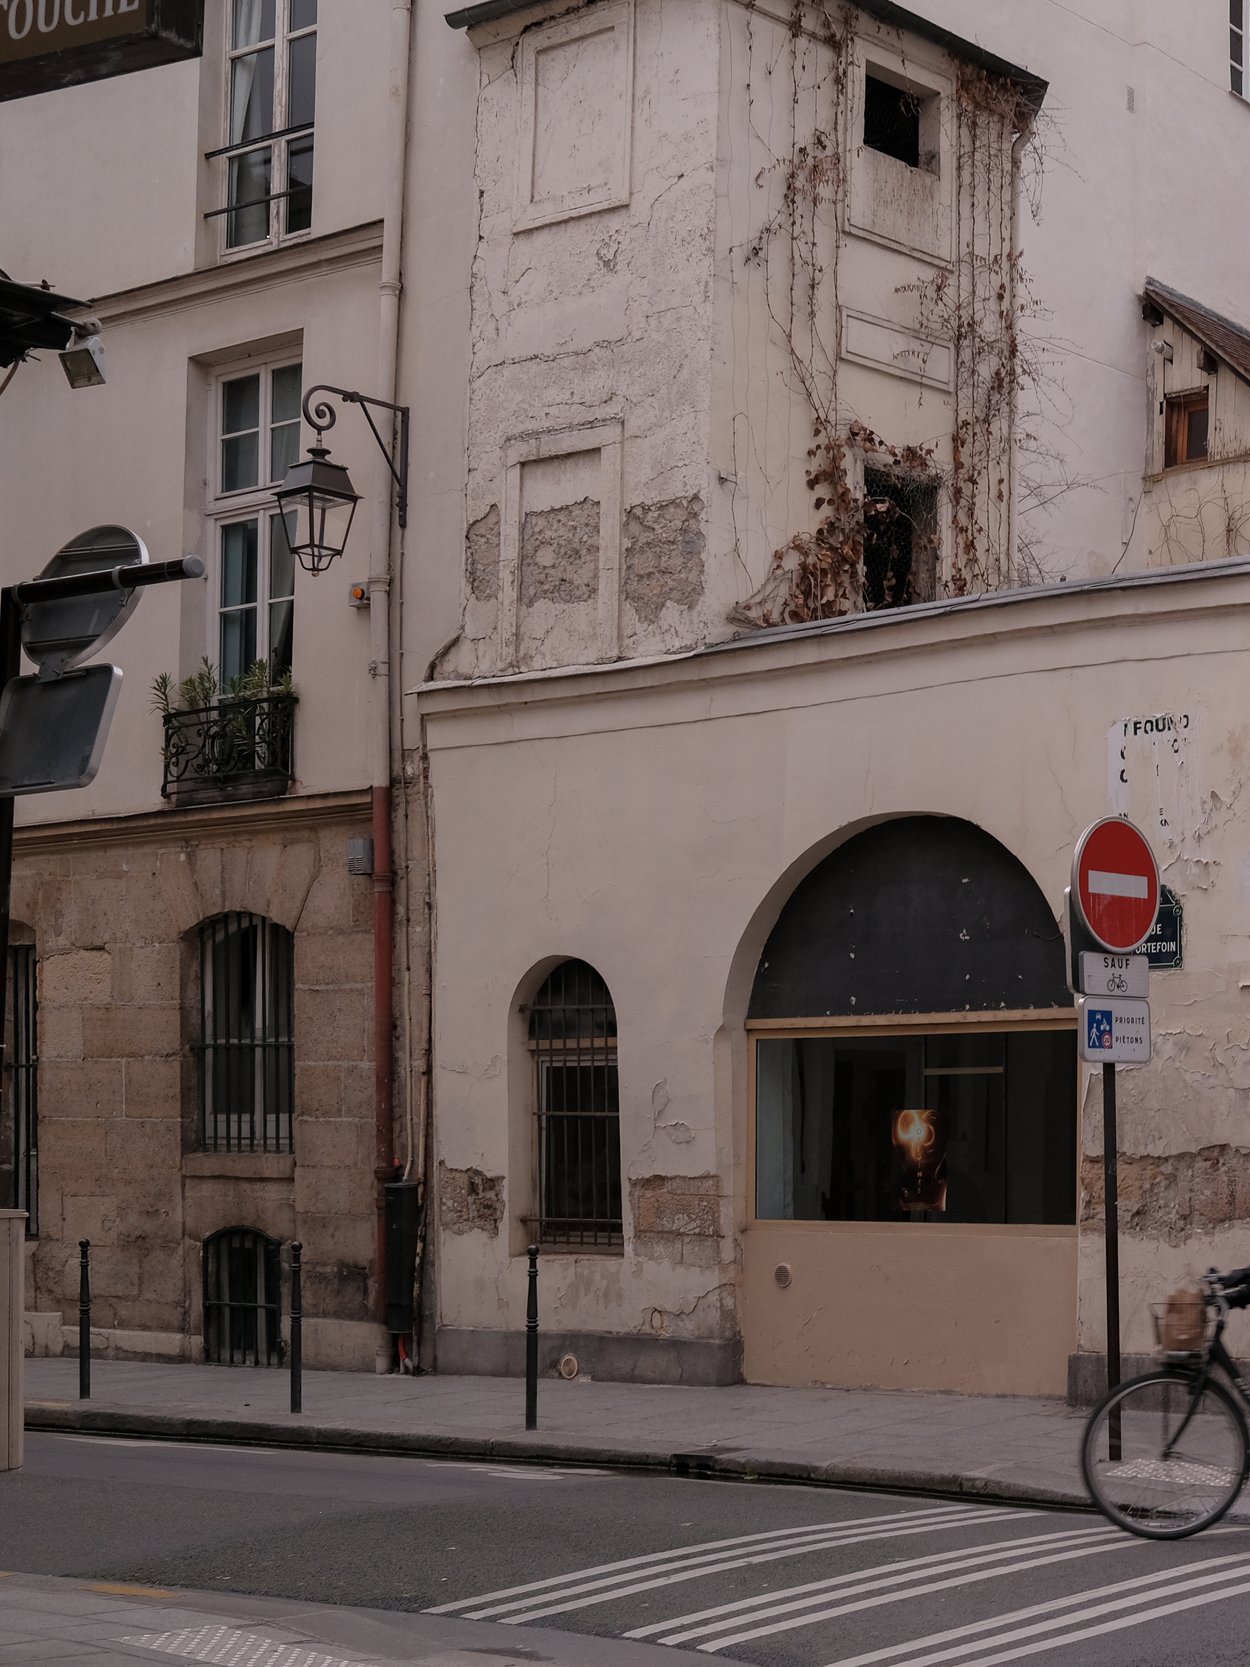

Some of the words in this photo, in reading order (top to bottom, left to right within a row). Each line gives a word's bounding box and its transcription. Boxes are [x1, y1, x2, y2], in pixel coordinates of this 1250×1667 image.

[1150, 923, 1163, 935] UE
[1135, 941, 1176, 954] ORTEFOIN
[1103, 956, 1131, 970] SAUF
[1114, 1016, 1146, 1025] PRIORITÉ
[1115, 1035, 1144, 1045] PIÉTONS
